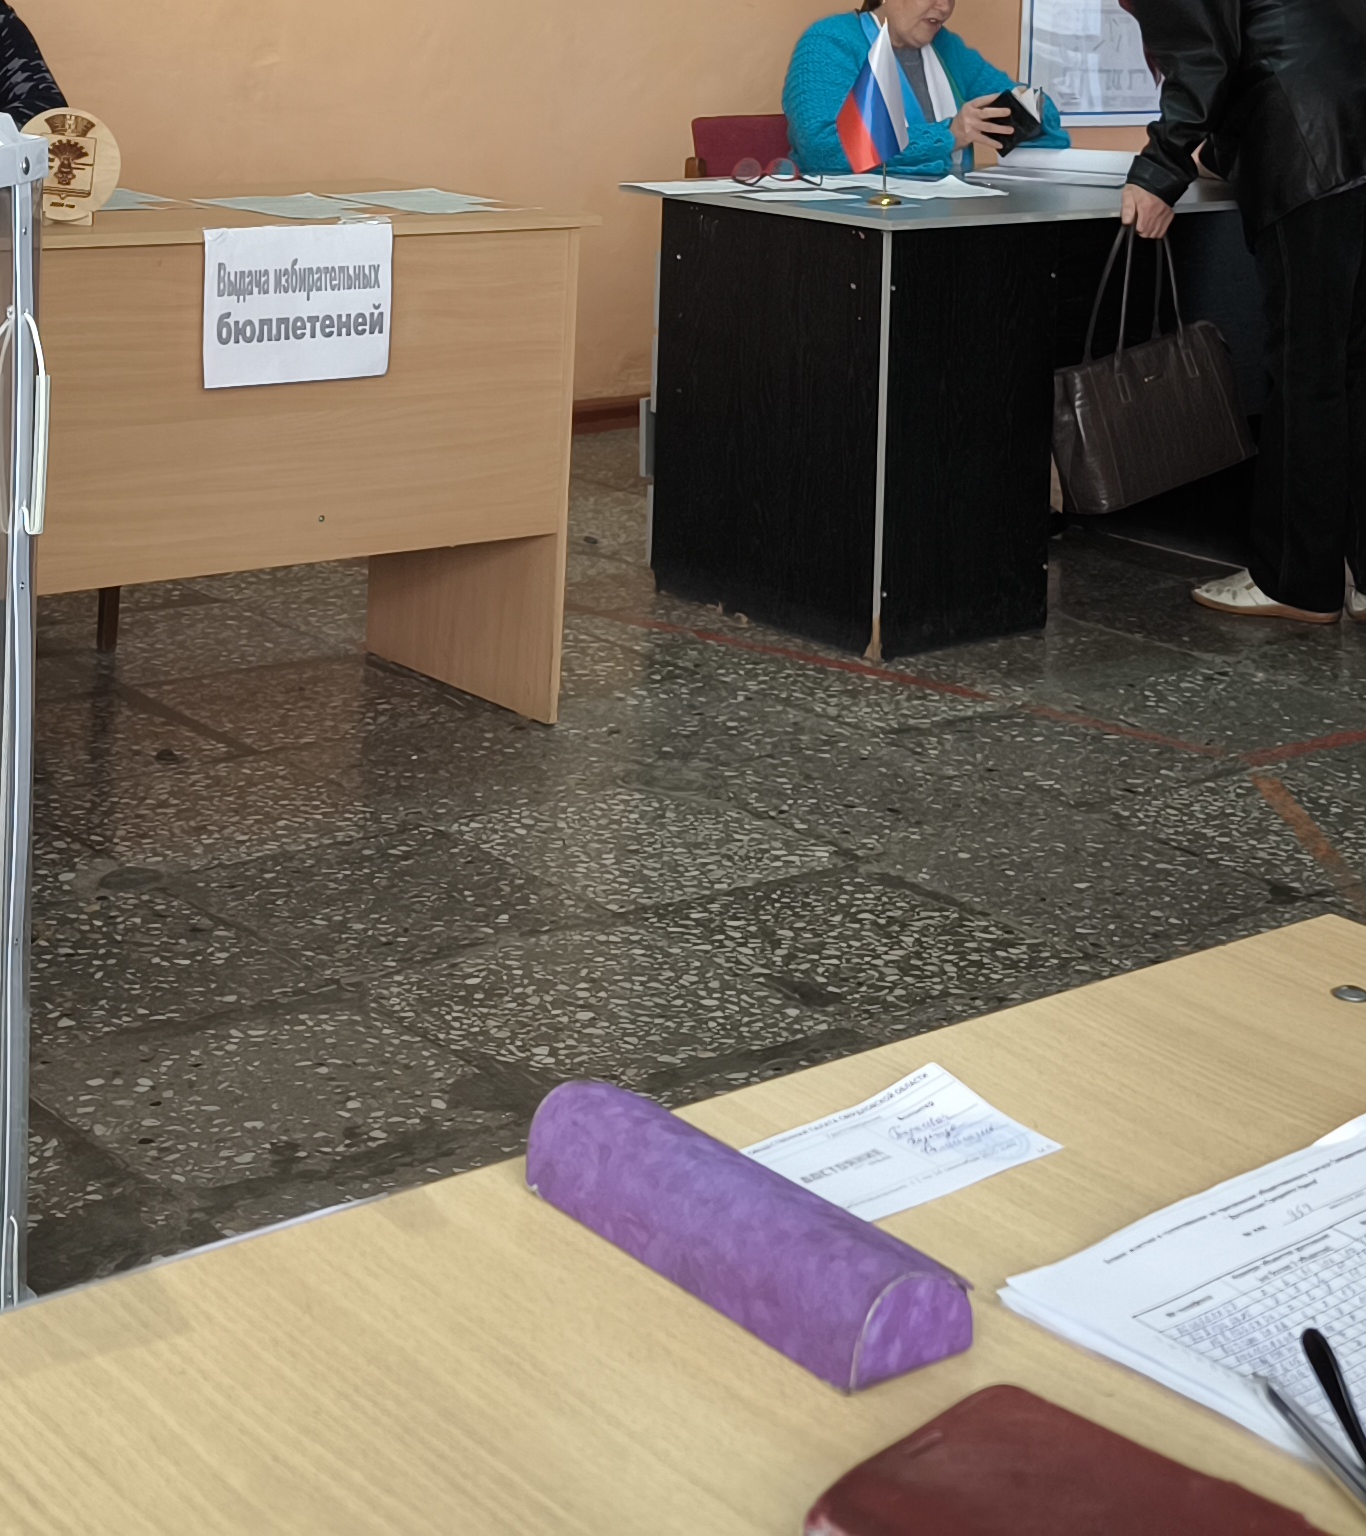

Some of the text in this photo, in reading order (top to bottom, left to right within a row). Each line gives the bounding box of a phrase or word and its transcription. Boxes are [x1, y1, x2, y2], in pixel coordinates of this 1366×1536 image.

[217, 258, 381, 303] Выдача избирательных
[216, 303, 384, 345] бюллетеней
